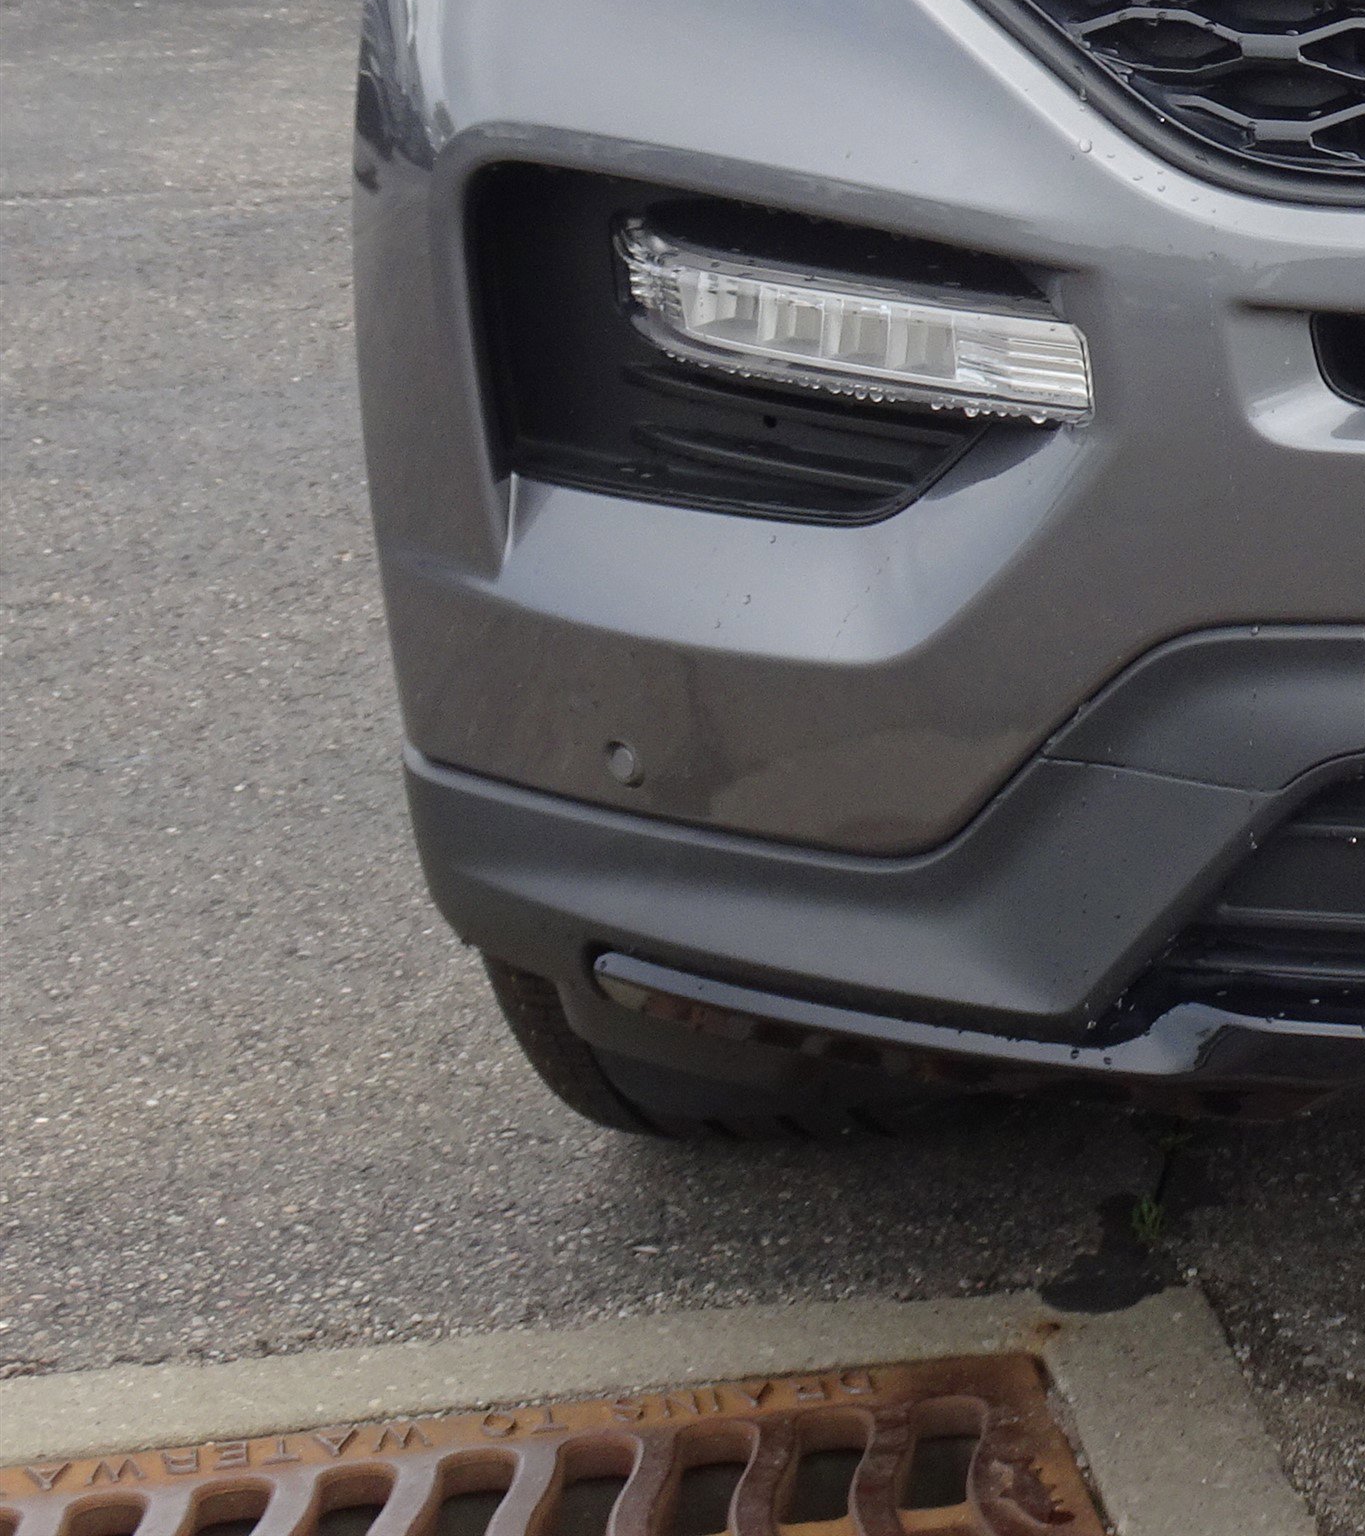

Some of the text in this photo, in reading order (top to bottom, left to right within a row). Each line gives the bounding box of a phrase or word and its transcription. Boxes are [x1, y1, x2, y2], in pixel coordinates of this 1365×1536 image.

[2, 1371, 874, 1494] DRAINS TO WATERWA
